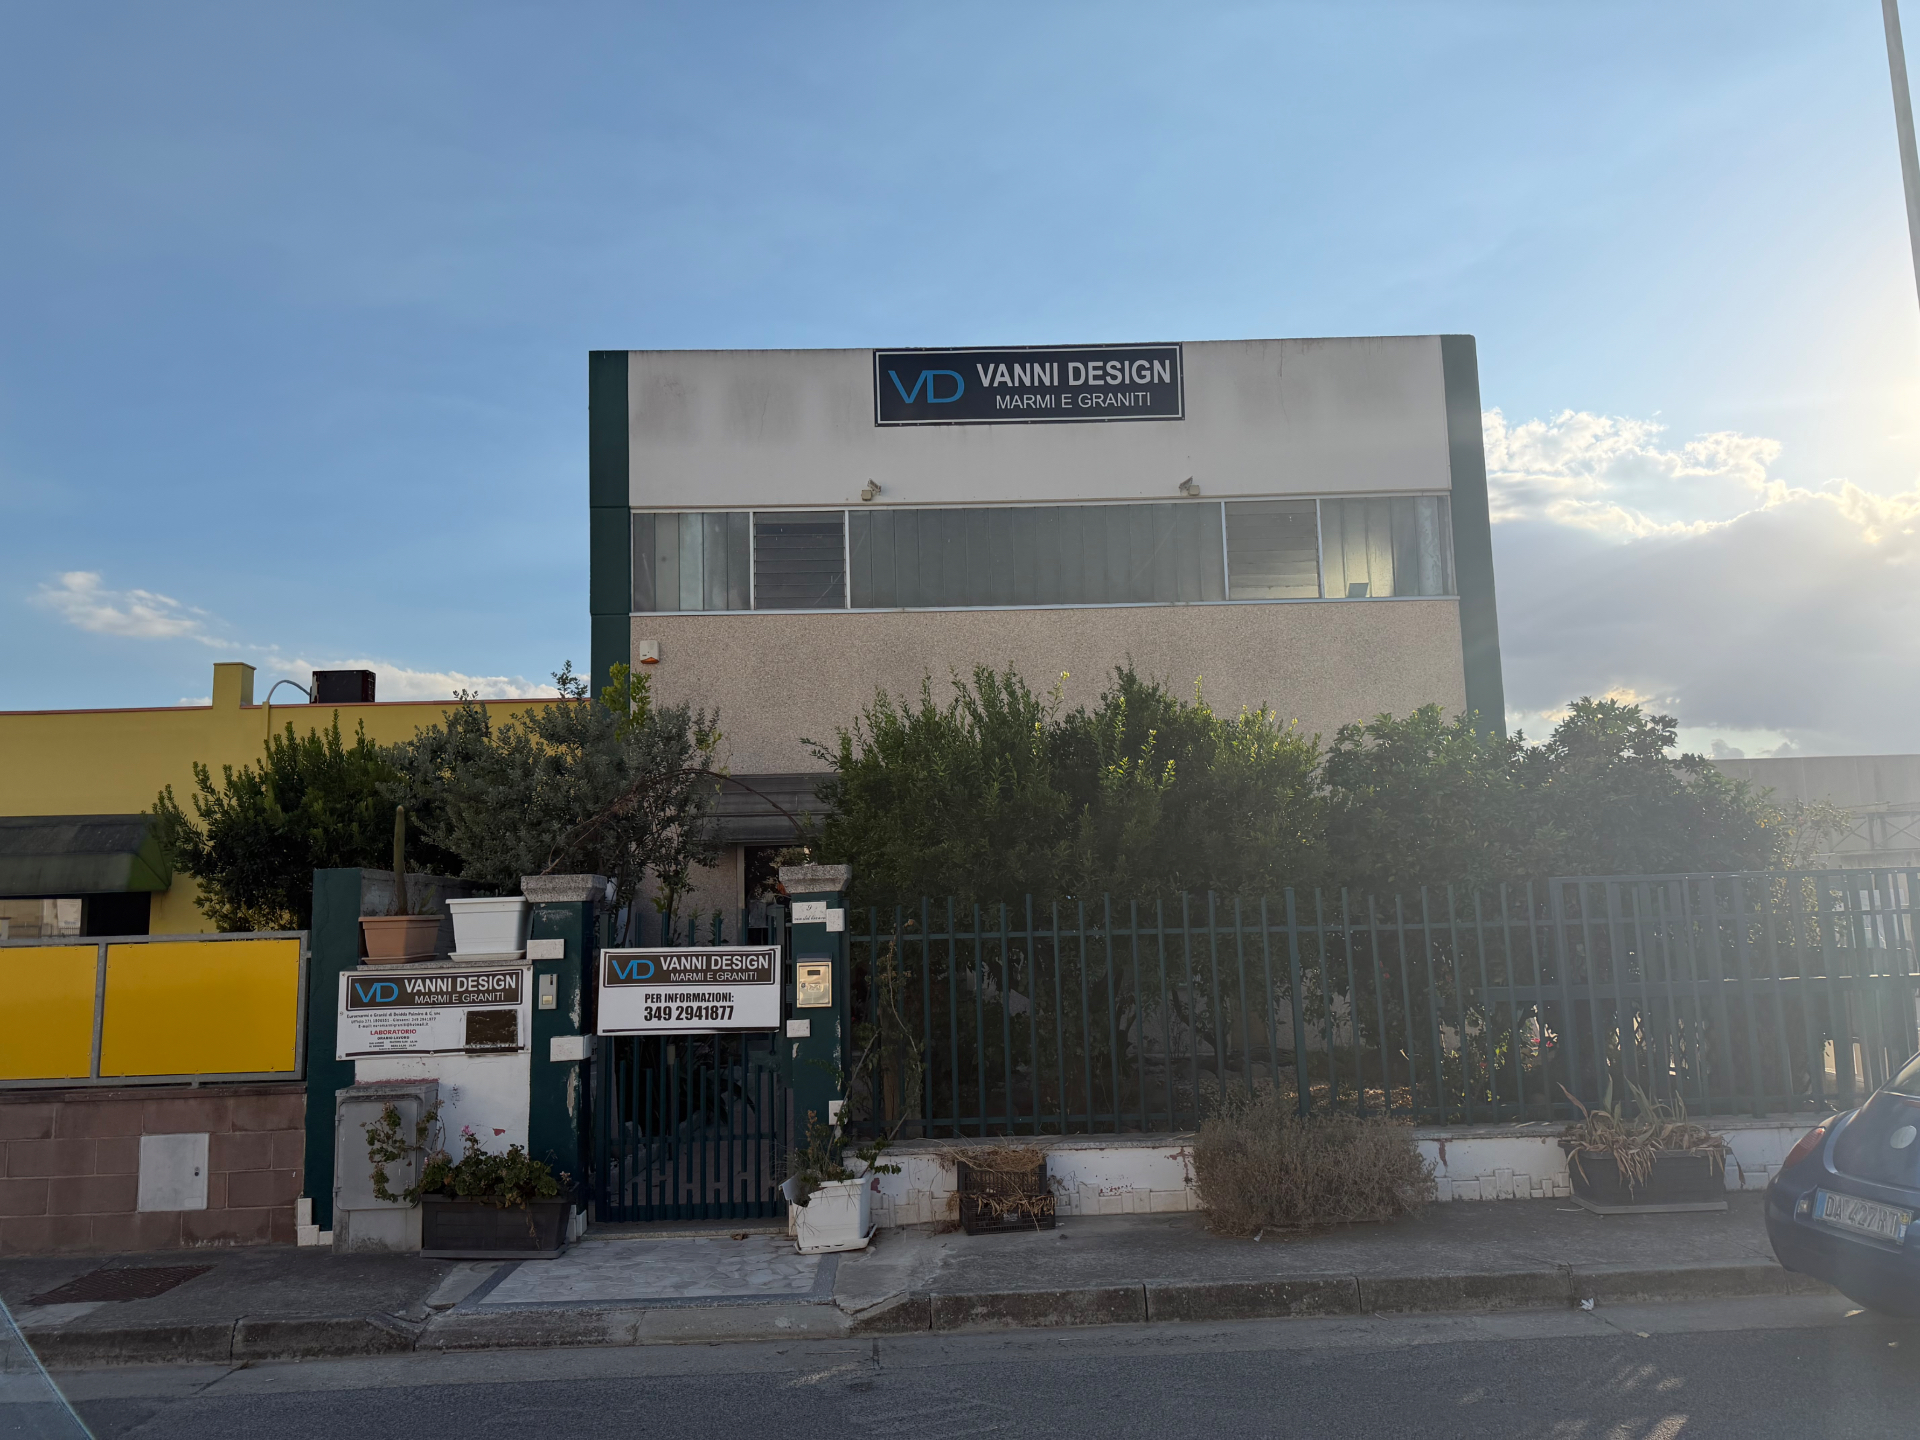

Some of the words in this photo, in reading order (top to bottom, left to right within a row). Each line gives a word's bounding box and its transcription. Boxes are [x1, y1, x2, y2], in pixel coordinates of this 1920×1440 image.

[976, 361, 1059, 387] VANNI
[1068, 359, 1171, 386] DESIGN
[888, 370, 965, 404] VD
[996, 395, 1055, 409] MARMI
[1062, 394, 1072, 408] E
[1078, 392, 1151, 408] GRANITI
[612, 959, 655, 980] VD
[660, 956, 707, 971] VANNI
[711, 955, 769, 970] DESIGN
[404, 978, 451, 993] VANNI
[456, 974, 517, 992] DESIGN
[670, 973, 704, 982] MARMI
[707, 972, 714, 981] E
[716, 971, 757, 981] GRANITI
[354, 982, 399, 1003] VD
[414, 994, 450, 1004] MARMI
[452, 994, 459, 1003] E
[461, 992, 505, 1002] GRANITI
[644, 993, 662, 1004] PER
[664, 992, 735, 1004] INFORMAZIONI:
[644, 1006, 672, 1022] 349
[675, 1005, 735, 1021] 2941877
[370, 1028, 417, 1036] LABORATORIO
[1825, 1195, 1844, 1220] DA
[1848, 1200, 1899, 1236] 427RT
